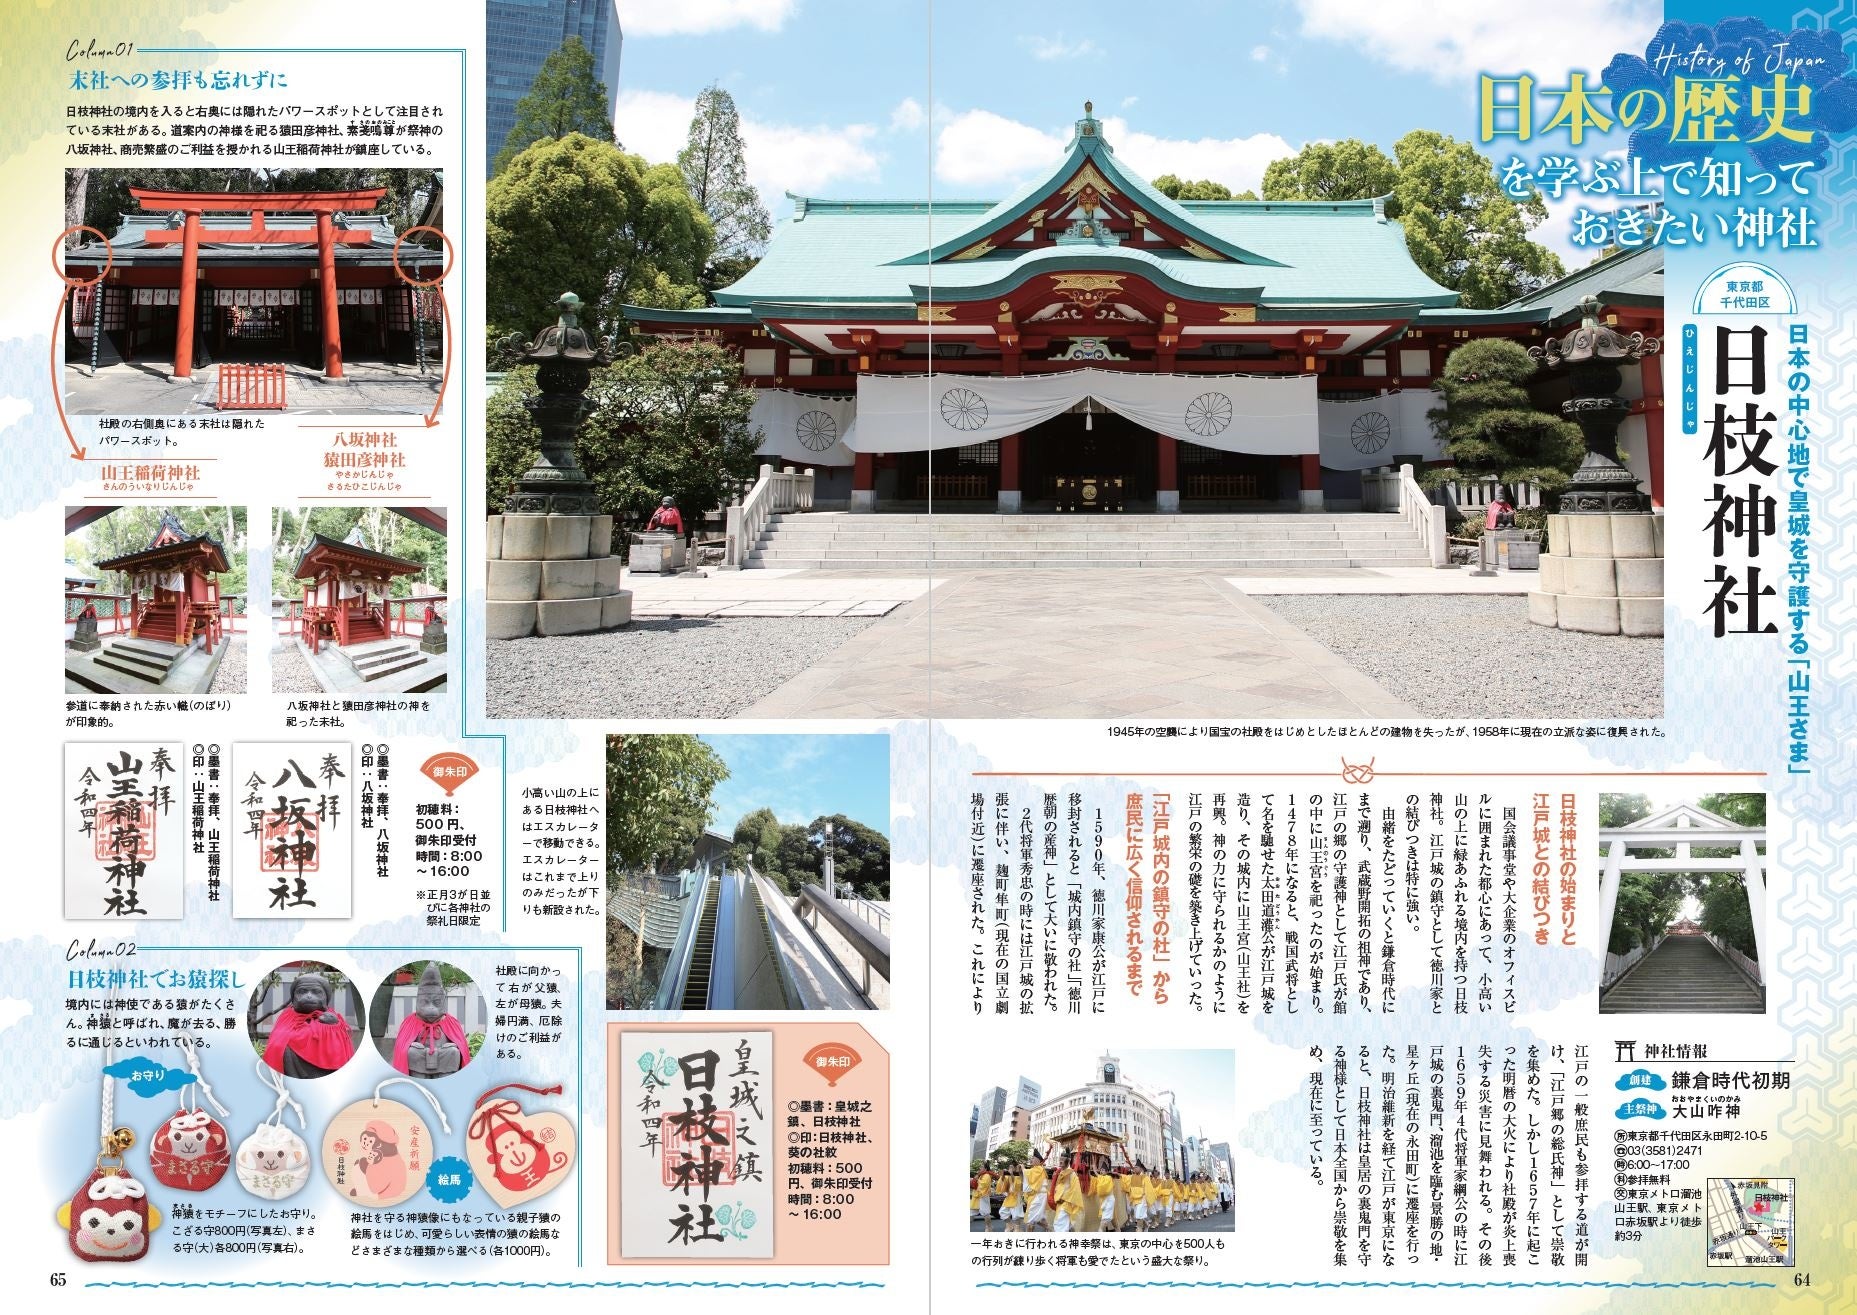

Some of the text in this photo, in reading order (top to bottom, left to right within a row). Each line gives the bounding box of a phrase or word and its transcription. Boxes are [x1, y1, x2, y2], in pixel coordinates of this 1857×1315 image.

[1654, 42, 1826, 79] History of Japan
[69, 70, 288, 91] 末社への参拝も忘れずに
[66, 105, 443, 118] 日枝神社の境内を入ると右奥には隠れたパワースポットとして注目され
[1480, 74, 1815, 145] 日本の歴史
[66, 143, 434, 156] 八坂神社、商売繁盛のご利益を授かれる山王稲荷神社が鎮座している。
[1501, 157, 1814, 198] を学ぶ上で知って
[1572, 207, 1817, 248] おきたい神社
[1727, 281, 1763, 293] 東京都
[1720, 296, 1770, 309] 千代田区
[1685, 329, 1694, 428] ひえじんじゃ
[99, 418, 265, 430] 社殿の右側奥にある末社は隠れた
[99, 435, 179, 447] パワースポット。
[333, 432, 398, 448] 八坂神社
[324, 452, 406, 468] 猿田彦神社
[101, 464, 200, 481] 山王稲荷神社
[336, 470, 394, 479] やさかじんじゃ
[103, 482, 194, 491] さんのういなりじんじゃ
[327, 482, 402, 491] さるたひこじんじゃ
[1702, 325, 1779, 639] 日枝神社
[1787, 324, 1811, 775] 日本の中心地で皇城を守護する「山王さま」
[287, 700, 430, 712] 八坂神社と猿田彦神社の神を
[66, 716, 115, 728] が印象的。
[286, 716, 346, 728] 祀った末社。
[433, 765, 467, 778] 御朱印
[148, 747, 176, 816] 奉拝
[319, 753, 346, 831] 奉拝
[522, 787, 599, 799] 小高い山の上に
[74, 767, 101, 838] 令和四年
[240, 771, 267, 840] 令和四年
[522, 804, 599, 816] ある日枝神社へ
[104, 751, 147, 916] 山王稲荷神社
[522, 821, 599, 832] はエスカレータ
[269, 759, 317, 911] 八坂神社
[415, 834, 477, 847] 御朱印受付
[522, 855, 599, 865] エスカレーター
[1405, 793, 1420, 932] の結びつきは特に強い。
[522, 871, 599, 882] はこれまで上り
[1532, 793, 1550, 945] 江戸城との結びつき
[1560, 793, 1577, 946] 日枝神社の始まりと
[522, 887, 599, 899] のみだったが下
[1125, 793, 1143, 997] 庶民に広く信仰されるまで
[427, 902, 491, 913] びに各神社の
[523, 904, 600, 916] りも新設された。
[1019, 808, 1033, 1014] 2代将軍秀忠の時には江戸城の拡
[1092, 808, 1106, 1014] 1590年、徳川家康公が江戸に
[1188, 793, 1203, 1014] 江戸の繁栄の礎を築き上げていった。
[1212, 793, 1227, 1014] 再興。神の力に守られるかのように
[1285, 793, 1299, 1014] 1478年になると、戦国武将とし
[1310, 793, 1324, 1014] の中に山王宮を祀ったのが始まり。
[1333, 793, 1347, 1014] 江戸の郷の守護神として江戸氏が館
[1382, 807, 1396, 1014] 由緒をたどっていくと鎌倉時代に
[1429, 793, 1444, 1014] 神社。江戸城の鎮守として徳川家と
[1454, 793, 1468, 1014] 山の上に緑あふれる境内を持つ日枝
[1478, 793, 1492, 1014] ルに囲まれた都心にあって、小高い
[1502, 806, 1517, 1014] 国会議事堂や大企業のオフィスビ
[426, 915, 481, 927] 祭礼日限定
[496, 965, 561, 977] 社殿に向かっ
[68, 969, 245, 989] 日枝神社でお猿探し
[496, 982, 562, 994] て右が父猿、
[65, 998, 235, 1011] 境内には神使である猿がたくさ
[496, 998, 562, 1010] 左が母猿。夫
[496, 1015, 562, 1027] 婦円満、厄除
[66, 1036, 212, 1049] るに通じるといわれている。
[496, 1032, 561, 1043] けのご利益が
[497, 1049, 522, 1060] ある。
[1645, 1044, 1708, 1059] 神社情報
[816, 1055, 850, 1068] 御朱印
[131, 1069, 165, 1081] お守り
[1629, 1074, 1651, 1086] 創建
[1671, 1071, 1790, 1090] 鎌倉時代初期
[637, 1069, 664, 1158] 令和四年
[728, 1039, 763, 1183] 皇城之鎮
[1309, 1045, 1324, 1186] め、現在に至っている。
[1624, 1103, 1658, 1115] 主祭神
[1672, 1103, 1741, 1119] 大山咋神
[788, 1116, 860, 1127] 鎮、日枝神社
[667, 1049, 730, 1246] 日枝神社
[788, 1147, 838, 1158] 葵の社紋
[1333, 1045, 1348, 1266] る神様として日本全国から崇敬を集
[1358, 1045, 1372, 1266] ると、日枝神社は皇居の裏鬼門を守
[1381, 1045, 1396, 1266] た。明治維新を経て江戸が東京にな
[1454, 1045, 1468, 1266] 1659年4代将軍家綱公の時に江
[1478, 1045, 1493, 1266] 失する災害に見舞われる。その後
[1502, 1045, 1516, 1266] った明暦の大火により社殿が炎上喪
[1527, 1045, 1541, 1266] を集めた。しかし1657年に起こ
[1575, 1045, 1588, 1266] 江戸の一般庶民も参拝する道が開
[166, 1160, 214, 1175] まさる守
[438, 1174, 461, 1186] 絵馬
[788, 1177, 873, 1189] 円、御朱印受付
[1755, 1193, 1788, 1202] 日枝神社
[172, 1208, 317, 1220] 神猿をモチーフにしたお守り。
[1614, 1203, 1702, 1214] 山王駅、東京メト
[351, 1212, 561, 1224] 神社を守る神猿像にもなっている親子猿の
[1615, 1216, 1702, 1228] ロ赤坂駅より徒歩
[1614, 1230, 1643, 1242] 約3分
[50, 1273, 66, 1287] 65
[1794, 1273, 1811, 1287] 64
